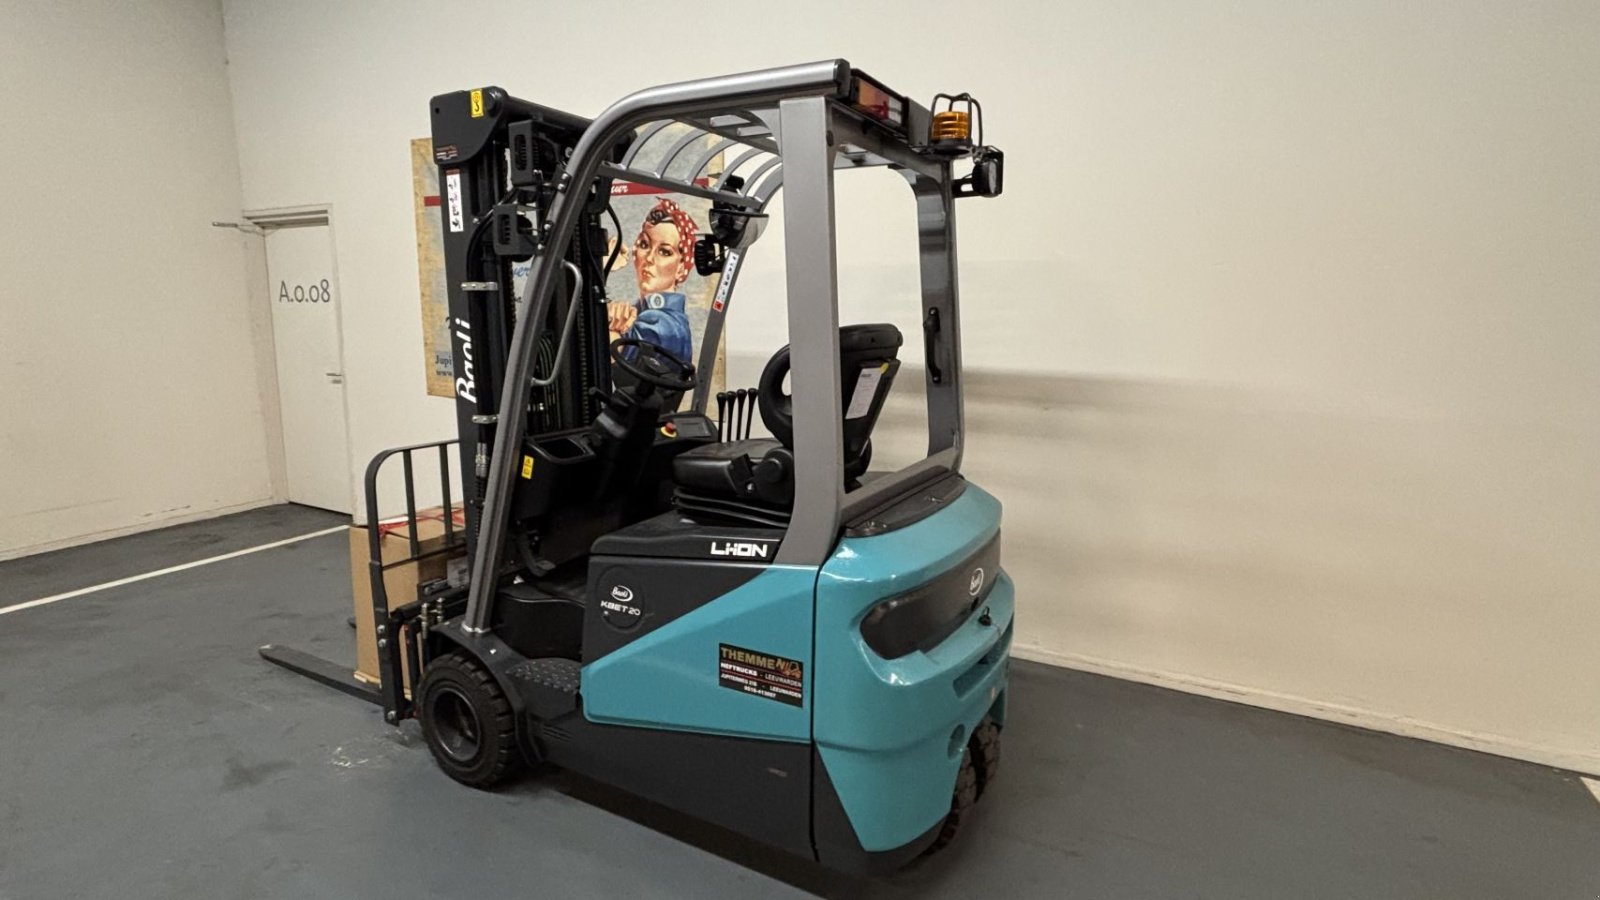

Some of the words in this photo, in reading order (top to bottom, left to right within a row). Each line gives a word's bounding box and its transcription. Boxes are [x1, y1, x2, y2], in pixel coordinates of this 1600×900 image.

[455, 317, 477, 404] Baoli
[628, 607, 641, 616] 20
[721, 648, 785, 670] THEMMEN
[721, 662, 758, 676] HEFTRUCKS
[765, 673, 802, 687] LEEUWARDEN
